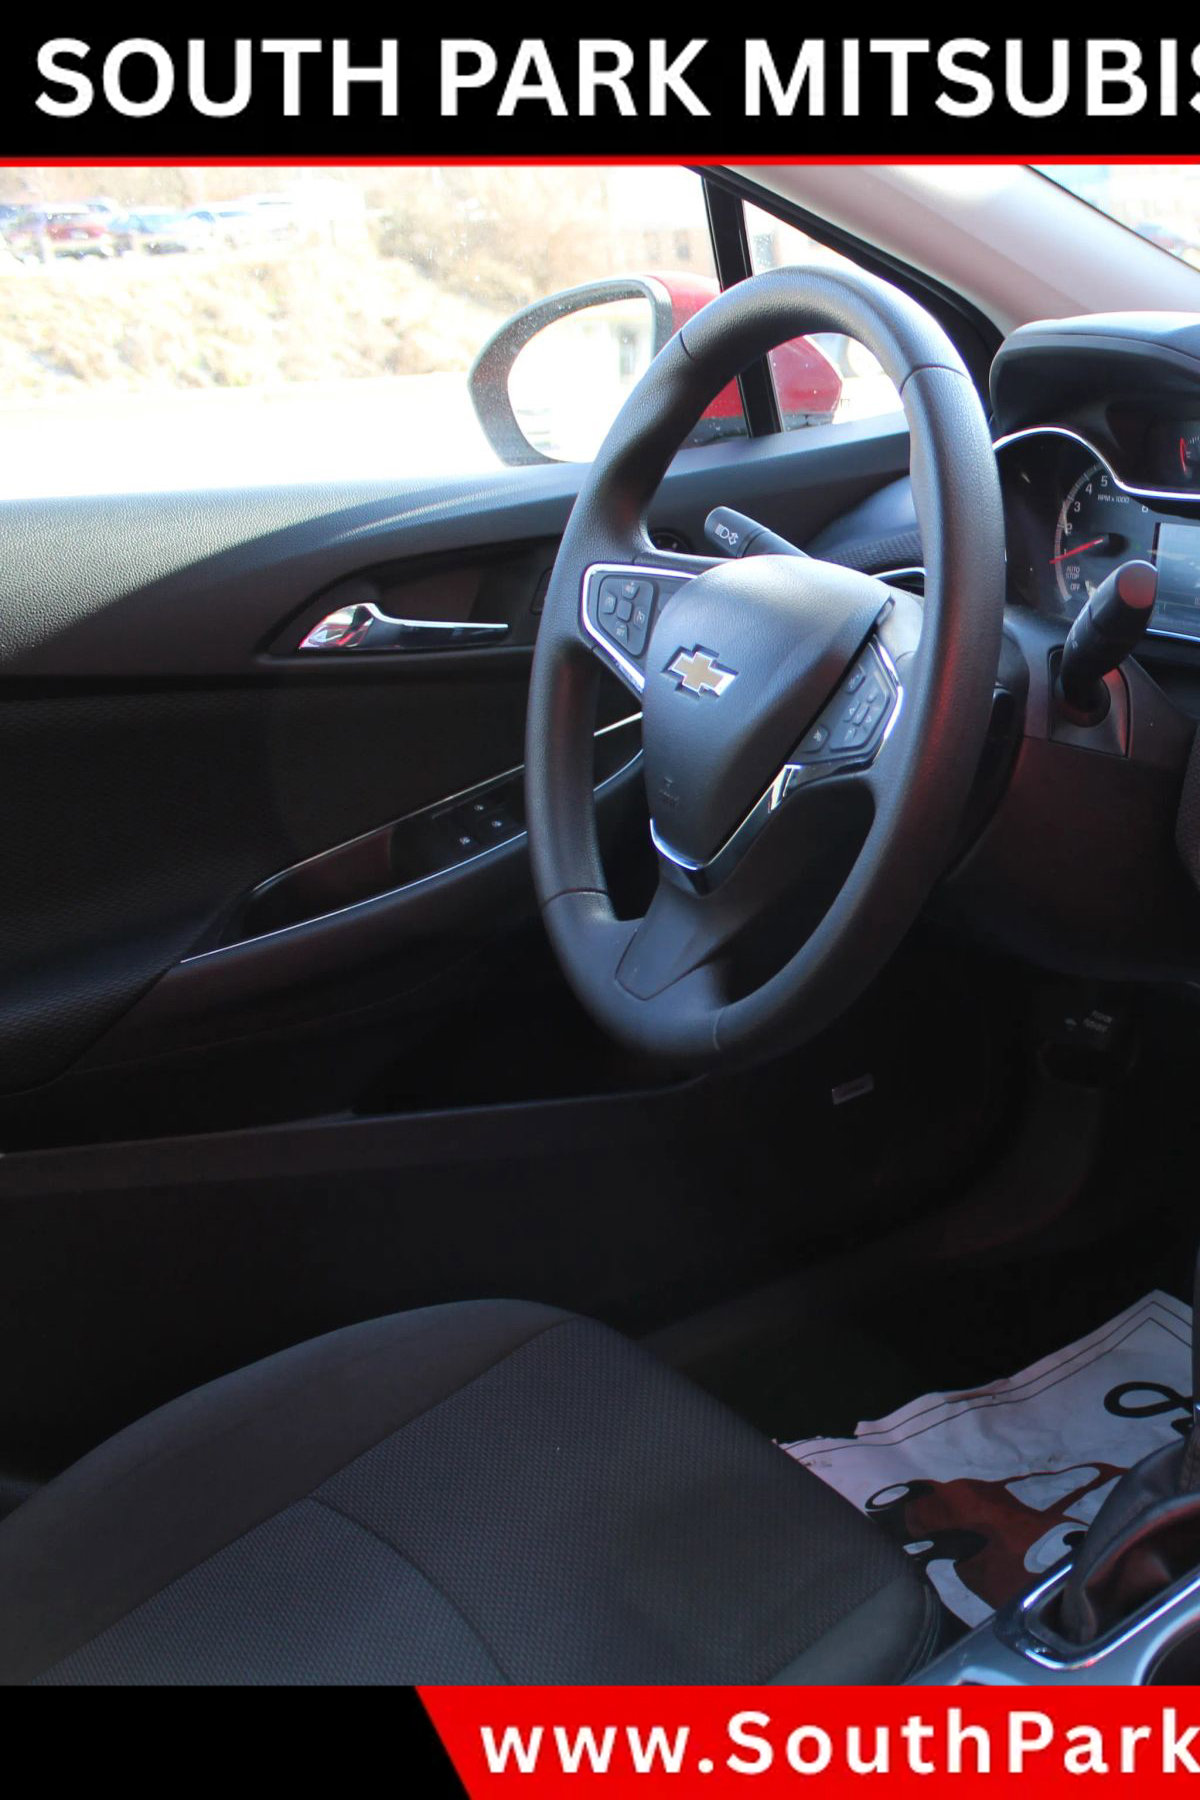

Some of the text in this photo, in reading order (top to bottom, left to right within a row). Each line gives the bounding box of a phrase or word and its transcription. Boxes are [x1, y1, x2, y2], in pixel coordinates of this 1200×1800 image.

[1101, 475, 1108, 487] 5
[1085, 482, 1093, 495] 4
[1073, 502, 1081, 513] 3
